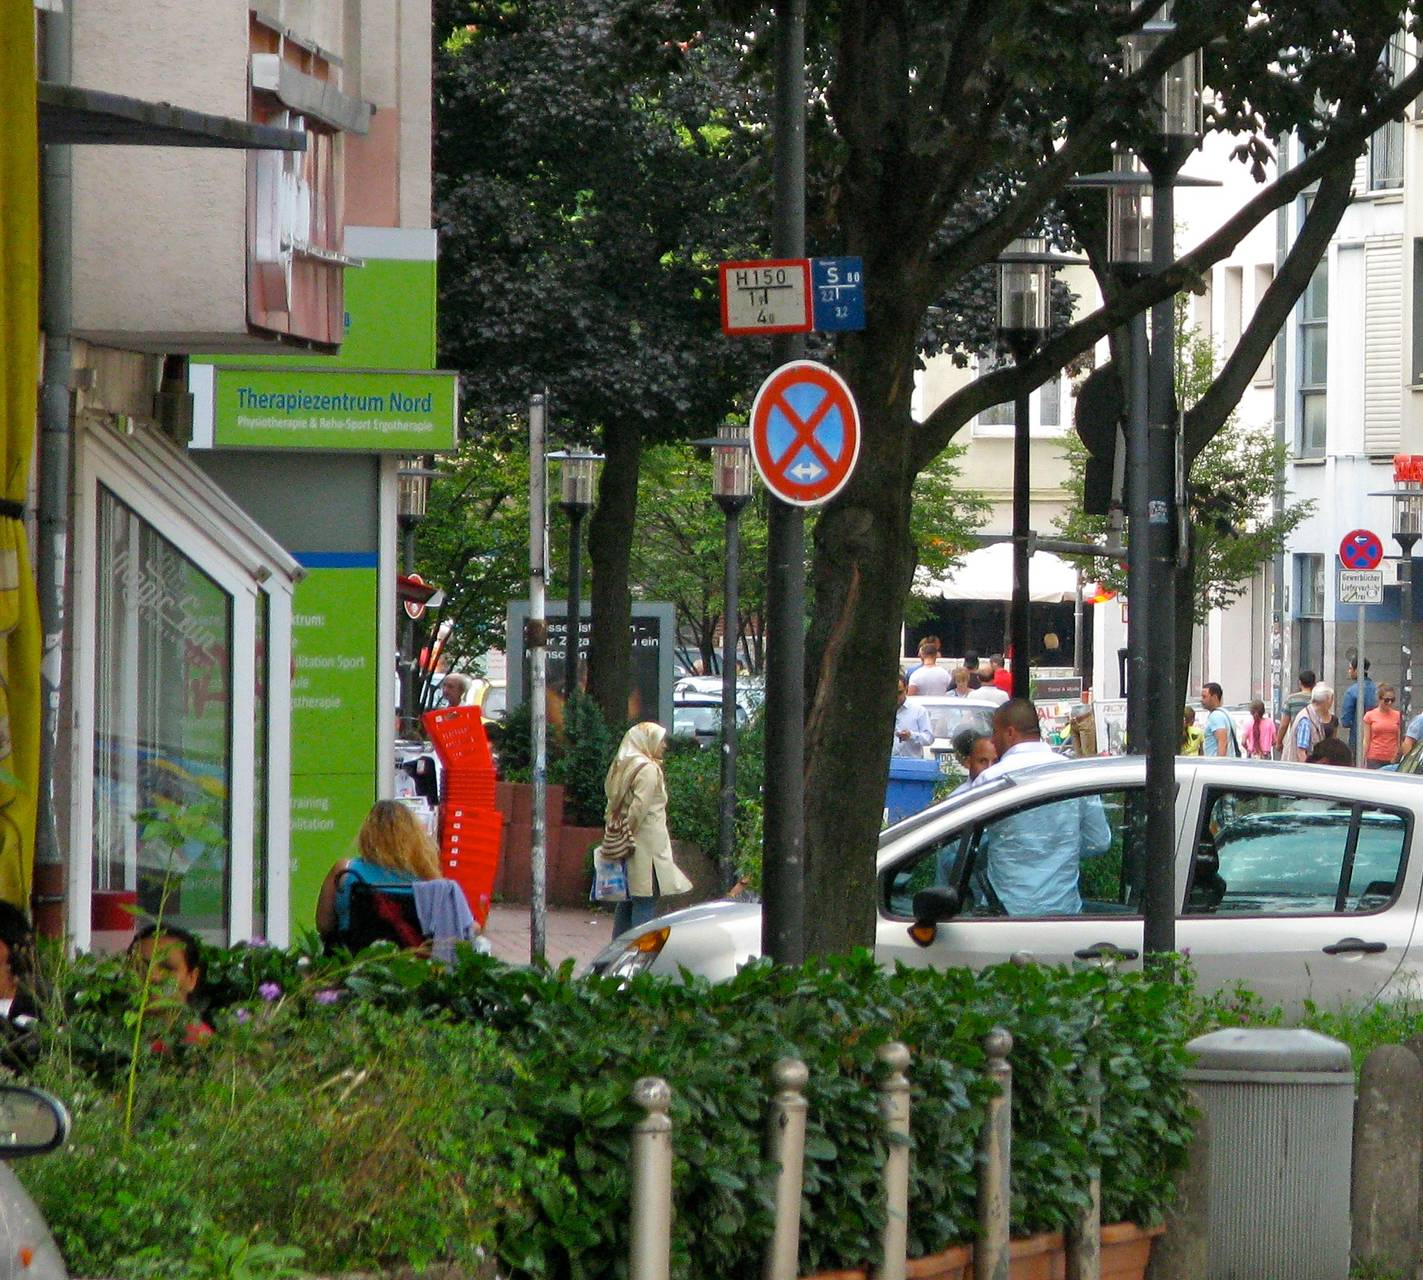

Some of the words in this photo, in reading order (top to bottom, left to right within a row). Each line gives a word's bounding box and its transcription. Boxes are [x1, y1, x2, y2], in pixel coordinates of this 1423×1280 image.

[736, 269, 786, 286] H150
[827, 267, 838, 283] S
[237, 388, 384, 414] Therapiezentrum
[389, 392, 433, 413] Nord
[237, 415, 307, 431] Physiotherapie
